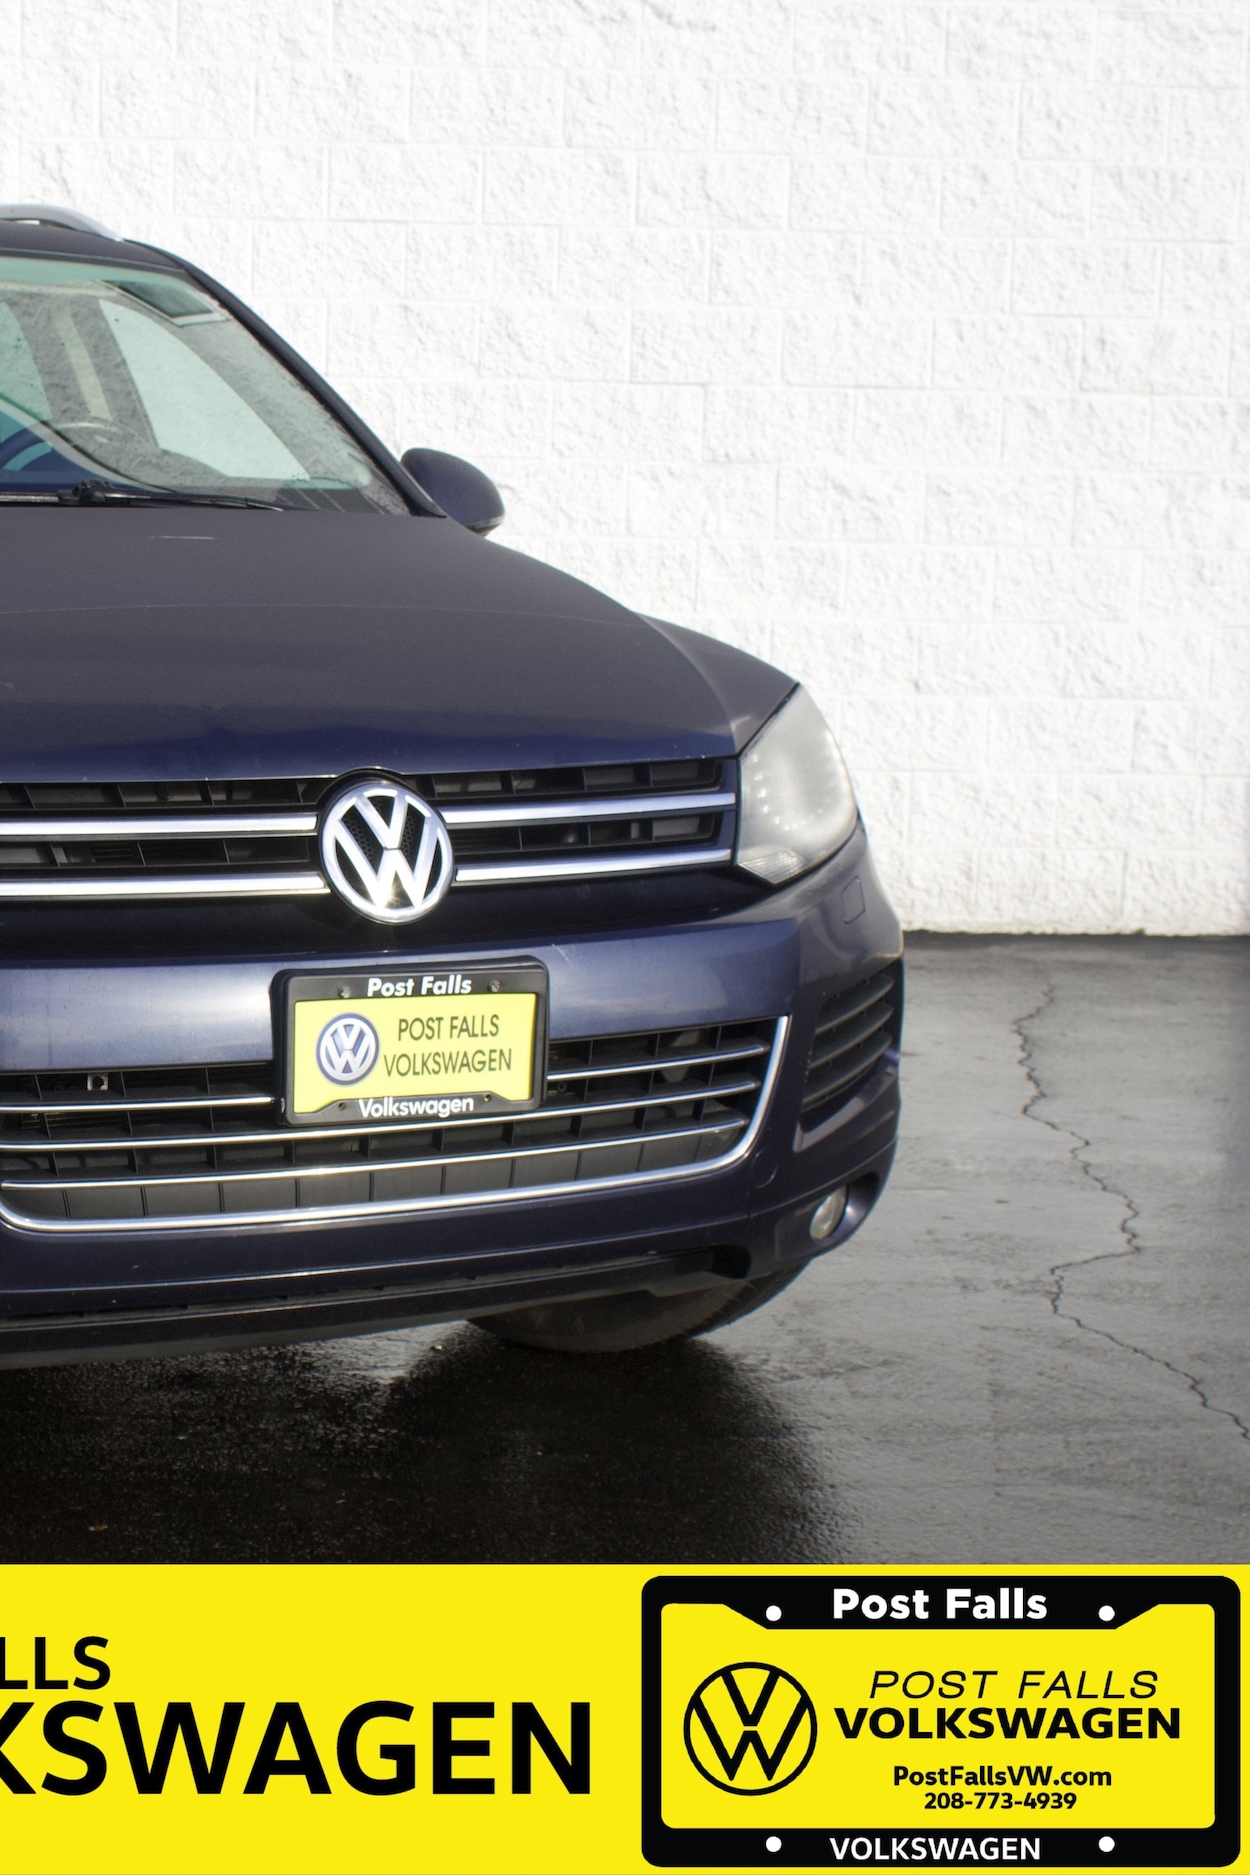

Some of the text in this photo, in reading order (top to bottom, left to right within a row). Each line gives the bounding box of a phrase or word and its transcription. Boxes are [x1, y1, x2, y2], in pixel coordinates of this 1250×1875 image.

[367, 974, 472, 998] Post Falls
[398, 1014, 499, 1041] POST FALLS
[383, 1048, 512, 1077] VOLKSWAGEN
[358, 1096, 474, 1119] Volkswagen
